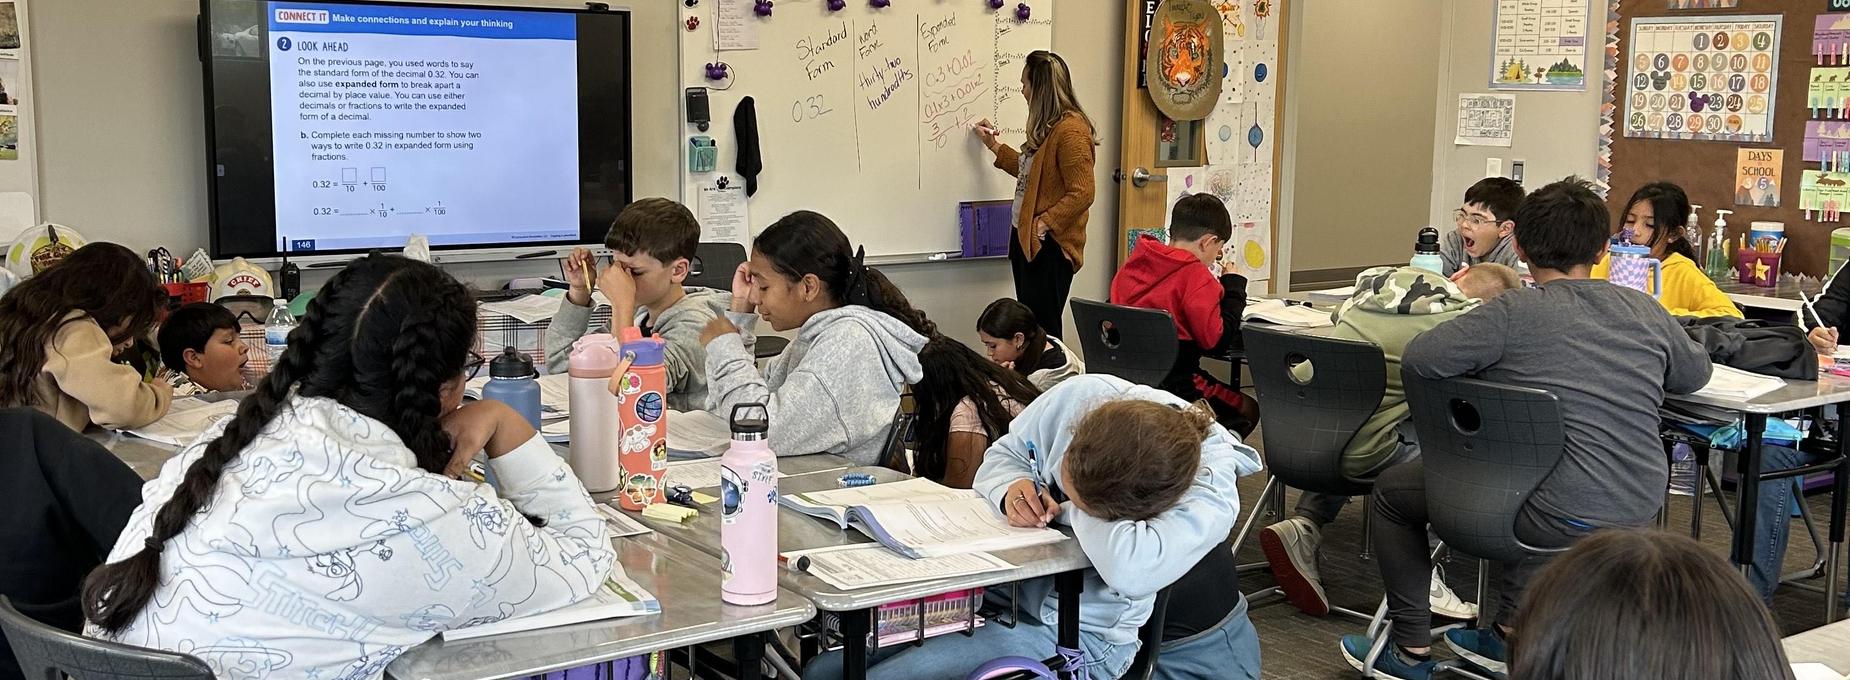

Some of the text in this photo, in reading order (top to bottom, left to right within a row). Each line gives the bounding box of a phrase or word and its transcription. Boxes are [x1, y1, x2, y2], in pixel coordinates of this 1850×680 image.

[278, 11, 316, 21] CONNECT
[319, 13, 326, 22] IT
[332, 14, 355, 22] Make
[357, 15, 409, 24] connections
[429, 18, 458, 27] explain
[461, 19, 479, 28] your
[481, 19, 513, 29] thinking
[920, 12, 956, 40] Expanded
[282, 38, 349, 52] 2 LOOK AHEAD
[796, 21, 847, 60] Standard
[928, 36, 949, 53] Form
[1699, 34, 1766, 48] 1 2 3 4
[298, 57, 310, 65] On
[1639, 55, 1766, 68] 5 6 7 8 9 10 11
[806, 60, 835, 80] Form
[1637, 75, 1646, 87] 12
[1673, 77, 1683, 88] 14
[1693, 76, 1703, 88] 15
[1713, 77, 1723, 88] 16
[1731, 77, 1742, 89] 17
[1754, 77, 1765, 89] 18
[333, 91, 342, 99] by
[1634, 95, 1763, 110] 19 20 21 23 24 25
[1632, 115, 1644, 127] 26
[1650, 116, 1661, 127] 27
[1669, 116, 1682, 127] 28
[1689, 118, 1700, 128] 29
[1708, 118, 1720, 129] 30
[311, 131, 350, 140] Complete
[374, 131, 404, 140] missing
[1748, 151, 1772, 161] DAYS
[1742, 166, 1776, 176] SCHOOL
[1760, 178, 1767, 189] 5
[231, 276, 259, 286] CHIEF
